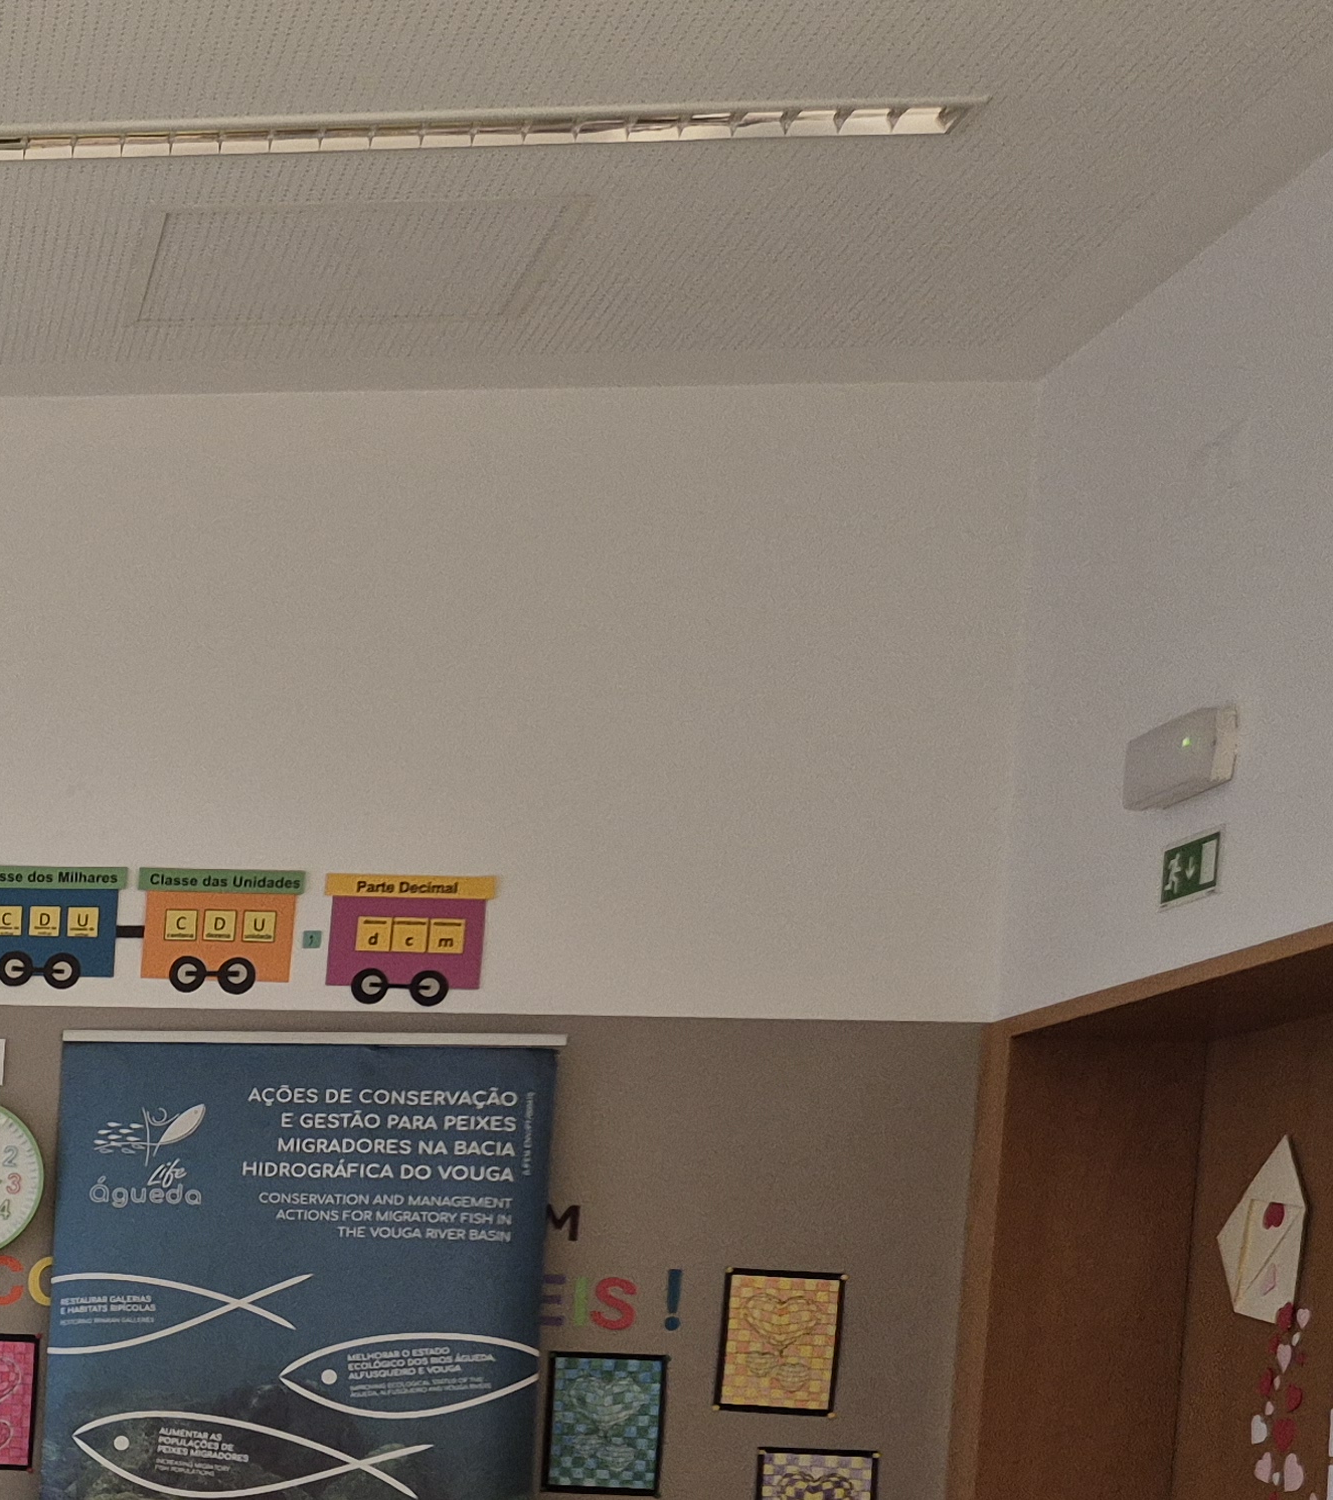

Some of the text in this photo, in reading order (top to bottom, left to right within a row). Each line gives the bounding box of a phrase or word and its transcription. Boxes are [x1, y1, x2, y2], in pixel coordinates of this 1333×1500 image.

[31, 870, 54, 883] dos
[58, 870, 118, 885] Milhares
[149, 873, 301, 890] Classe das Unidades
[356, 879, 458, 895] Parte Decimal
[1, 912, 12, 927] C
[39, 912, 51, 927] D
[77, 913, 89, 928] U
[176, 915, 188, 930] C
[213, 916, 225, 931] D
[253, 917, 265, 932] U
[368, 932, 379, 947] d
[404, 935, 415, 947] c
[438, 936, 454, 948] m
[247, 1085, 518, 1110] AÇÕES DE CONSERVAÇÃO
[281, 1110, 517, 1132] E GESTÃO PARA PEIXES
[277, 1137, 516, 1157] MIGRADORES NA BACIA
[2, 1145, 19, 1167] 2
[146, 1158, 188, 1188] Life
[242, 1159, 515, 1182] HIDROGRÁFICA DO VOUGA
[6, 1172, 22, 1194] 3
[89, 1175, 202, 1209] águeda
[258, 1192, 513, 1209] CONSERVATION AND MANAGEMENT
[275, 1209, 512, 1226] ACTIONS FOR MIGRATORY FISH IN
[337, 1226, 511, 1243] THE VOUGA RIVER BASIN
[347, 1350, 400, 1361] MELHORAR
[412, 1346, 451, 1357] ESTADO
[347, 1359, 405, 1371] ECOLÓGICO
[407, 1357, 428, 1367] DOS
[426, 1364, 462, 1374] VOUGA
[159, 1426, 223, 1442] AUMENTAR AS
[157, 1444, 250, 1463] PEIXES MIGRADORES
[221, 1443, 235, 1452] DE
